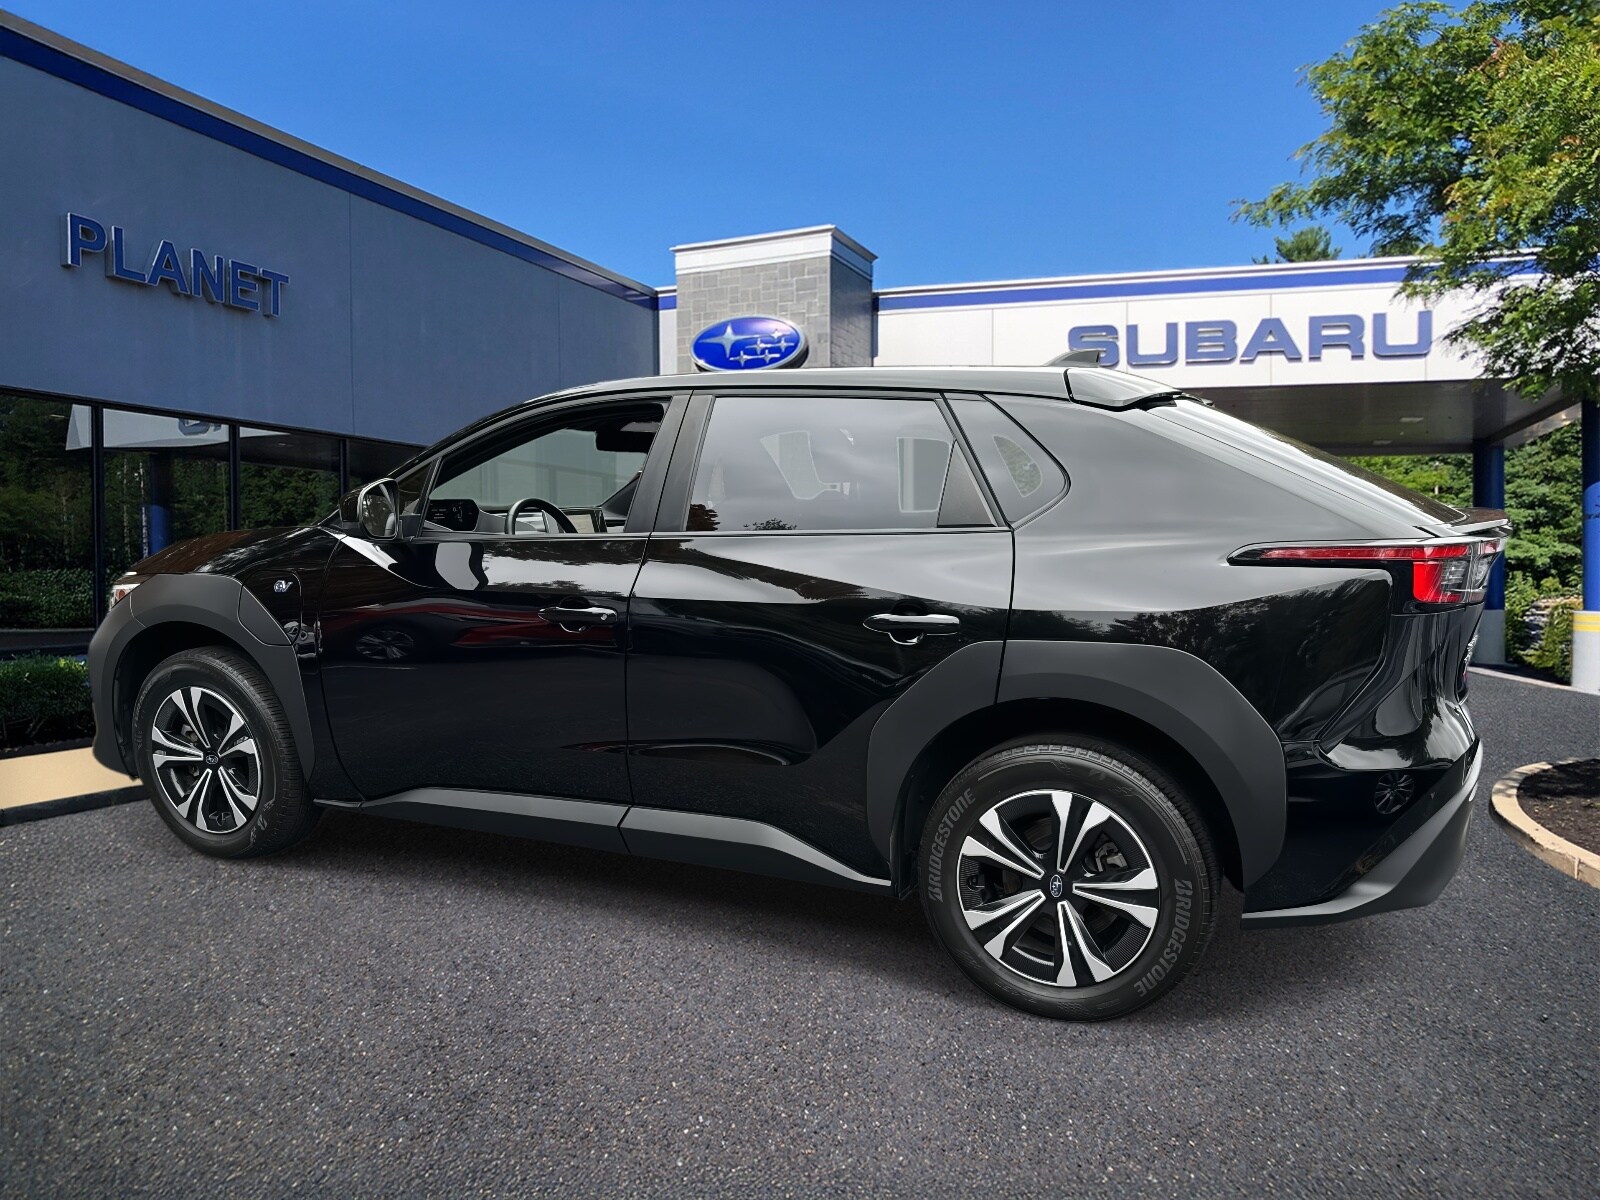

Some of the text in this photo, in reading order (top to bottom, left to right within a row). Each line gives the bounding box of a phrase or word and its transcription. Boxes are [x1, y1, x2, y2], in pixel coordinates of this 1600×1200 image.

[64, 212, 290, 317] PLANET
[1068, 310, 1433, 368] SUBARU
[928, 789, 976, 902] BRIDGESTONE
[1133, 878, 1193, 997] BRIDGESTONE
